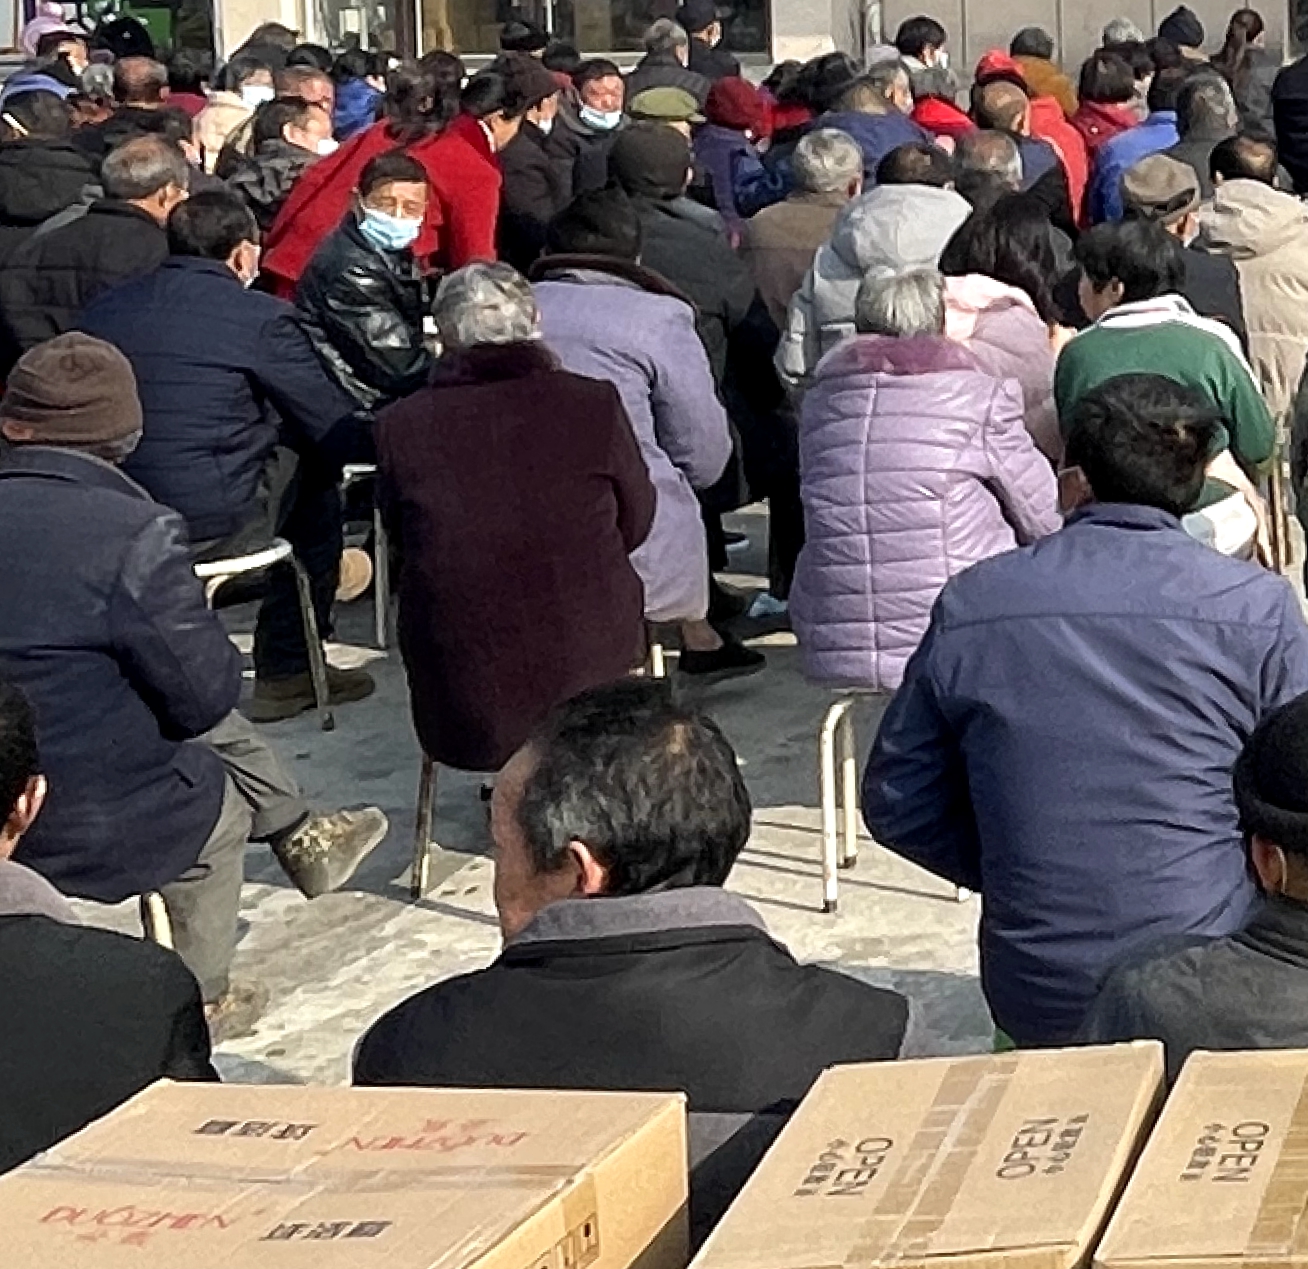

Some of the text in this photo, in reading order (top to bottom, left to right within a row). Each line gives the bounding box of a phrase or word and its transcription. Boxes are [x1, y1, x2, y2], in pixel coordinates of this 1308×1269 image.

[824, 1138, 893, 1198] OPEN
[996, 1118, 1058, 1179] OPEN
[1212, 1121, 1270, 1182] OPEN
